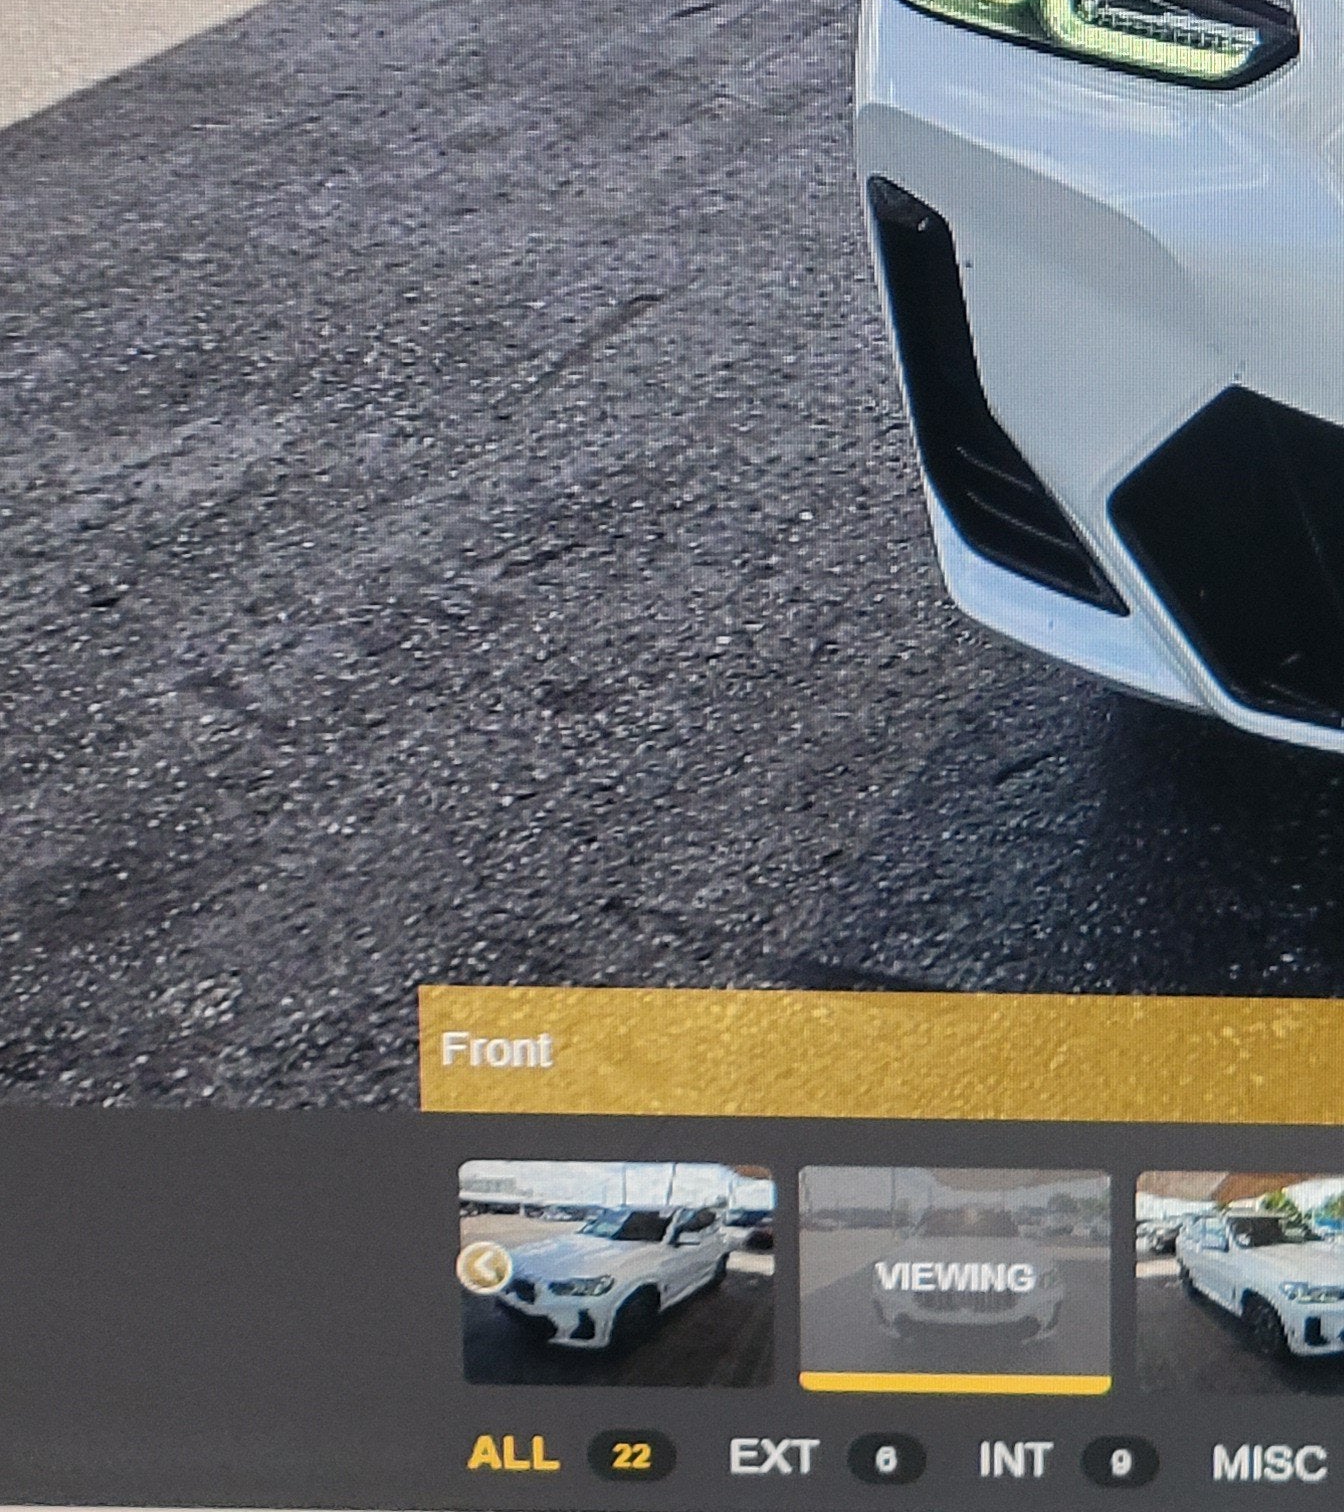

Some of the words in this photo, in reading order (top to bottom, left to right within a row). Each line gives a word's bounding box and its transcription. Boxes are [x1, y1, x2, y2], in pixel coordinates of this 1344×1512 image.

[442, 1031, 554, 1068] Front
[875, 1261, 1037, 1294] VIEWING
[467, 1435, 561, 1471] ALL
[612, 1443, 651, 1469] 22
[730, 1438, 821, 1475] EXT
[980, 1440, 1054, 1478] INT
[1213, 1444, 1328, 1482] MISC
